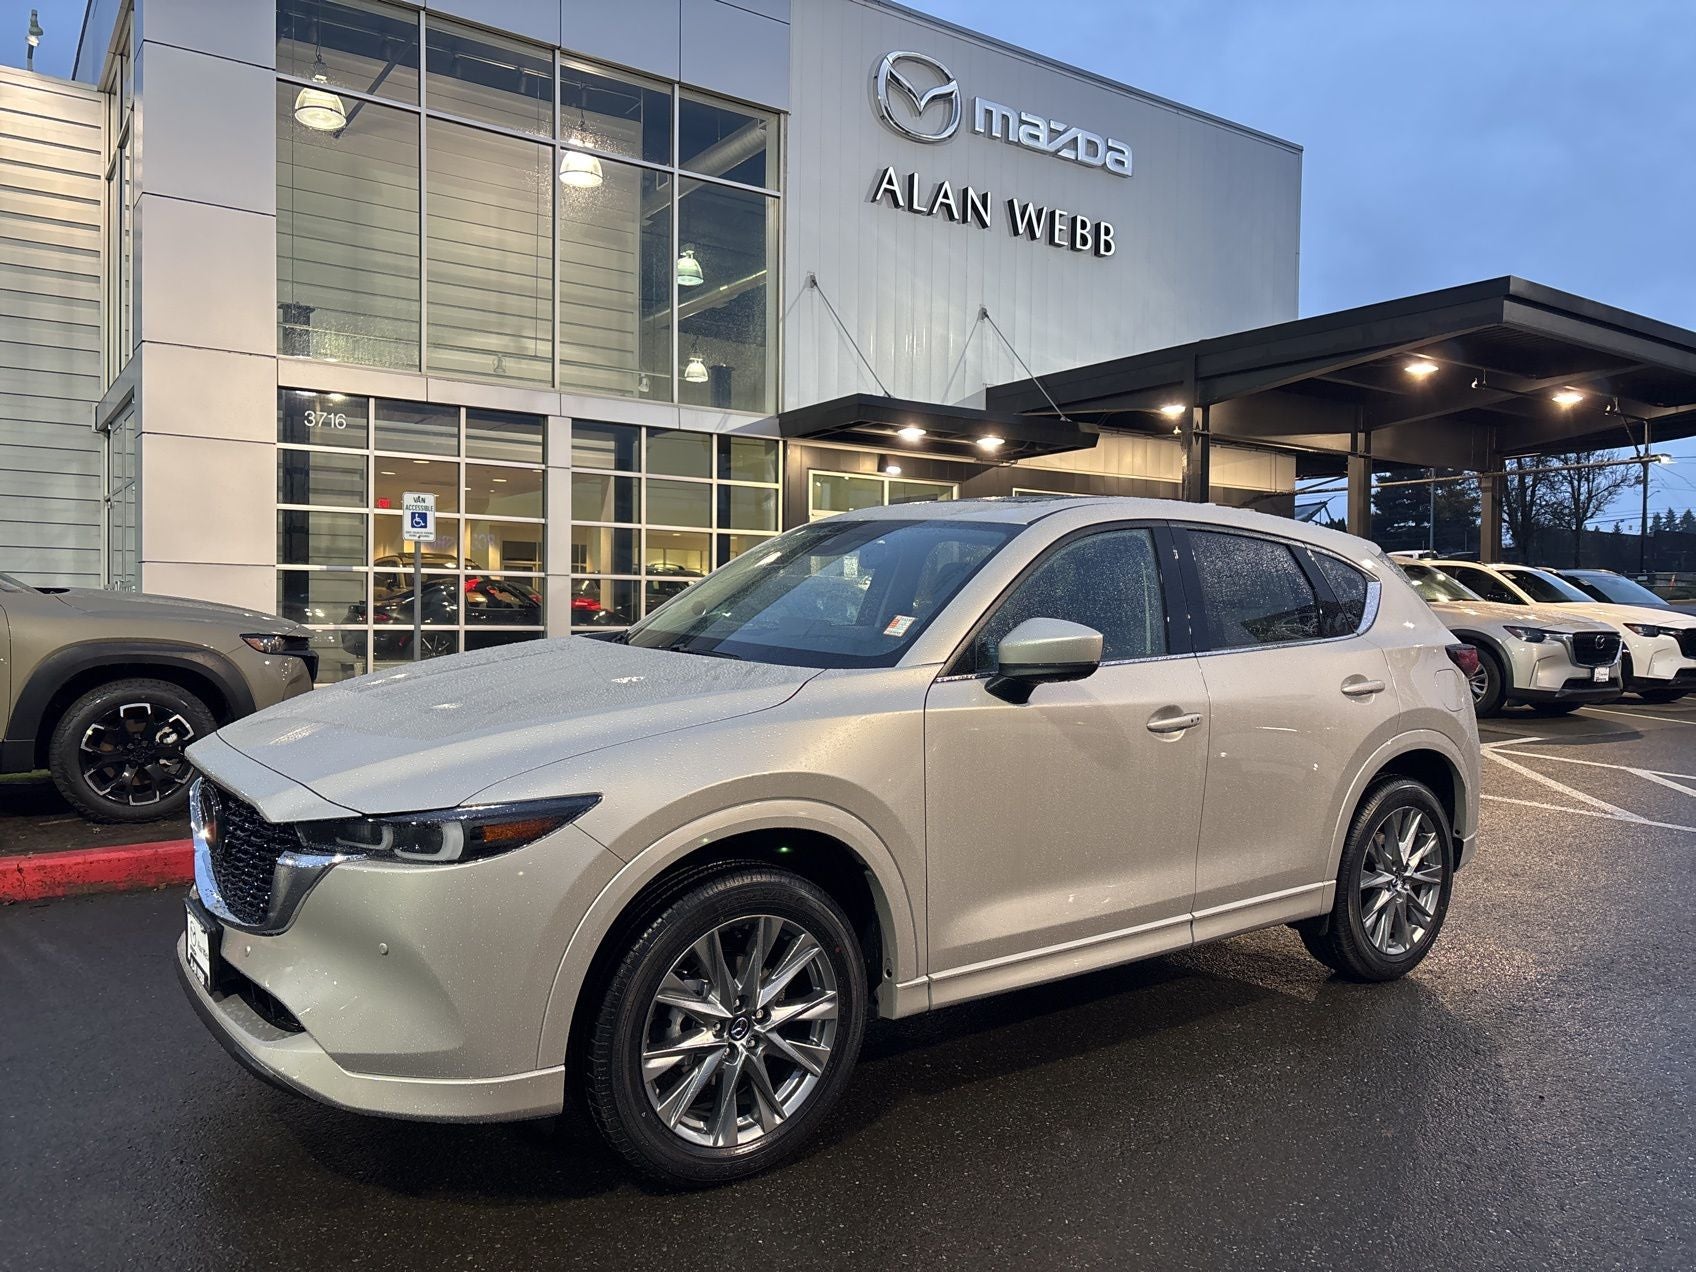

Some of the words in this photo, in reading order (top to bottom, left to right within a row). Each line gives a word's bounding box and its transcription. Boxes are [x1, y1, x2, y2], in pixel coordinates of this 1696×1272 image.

[973, 96, 1133, 177] mazda
[873, 166, 992, 229] ALAN
[1007, 197, 1116, 257] WEBB
[304, 410, 347, 429] 3716
[405, 504, 434, 512] ACCESSIBLE
[413, 496, 426, 504] VAN
